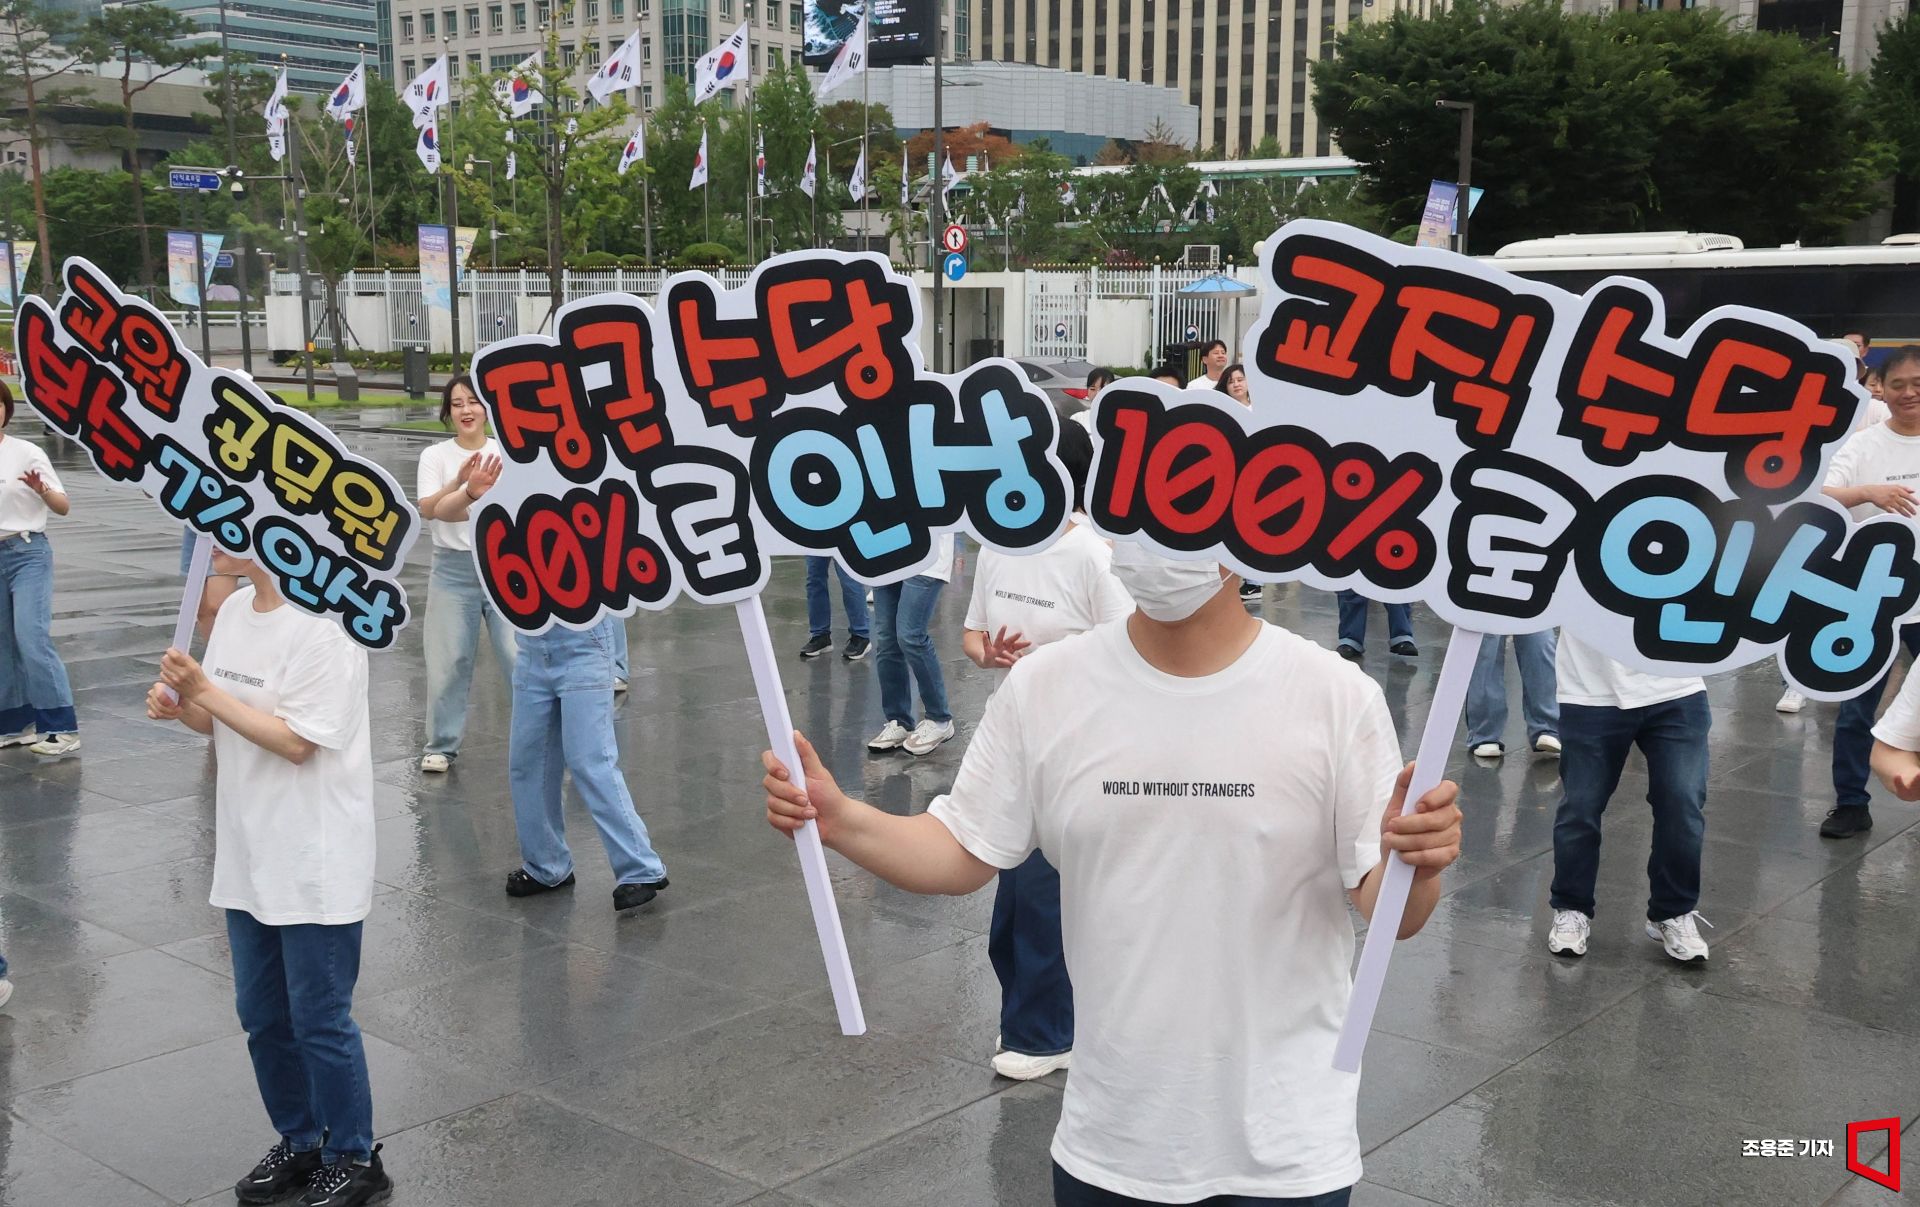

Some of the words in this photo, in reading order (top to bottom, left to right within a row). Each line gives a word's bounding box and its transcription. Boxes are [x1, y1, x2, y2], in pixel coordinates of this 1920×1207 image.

[65, 274, 183, 415] 교원
[212, 388, 400, 561] 공무원
[483, 319, 664, 470] 정근
[677, 277, 895, 423] 수당
[1272, 253, 1537, 436] 교직
[1576, 305, 1838, 489] 수당
[26, 314, 142, 470] 보수
[158, 444, 248, 546] 7%
[260, 525, 396, 642] 인상
[766, 388, 1046, 561] 인상
[1007, 592, 1026, 602] WITHOUT
[1026, 596, 1055, 608] STRANGERS
[1598, 494, 1907, 674] 인상
[240, 675, 264, 687] STRANGERS
[1102, 781, 1139, 795] WORLD
[1143, 782, 1189, 796] WITHOUT
[1192, 783, 1255, 797] STRANGERS
